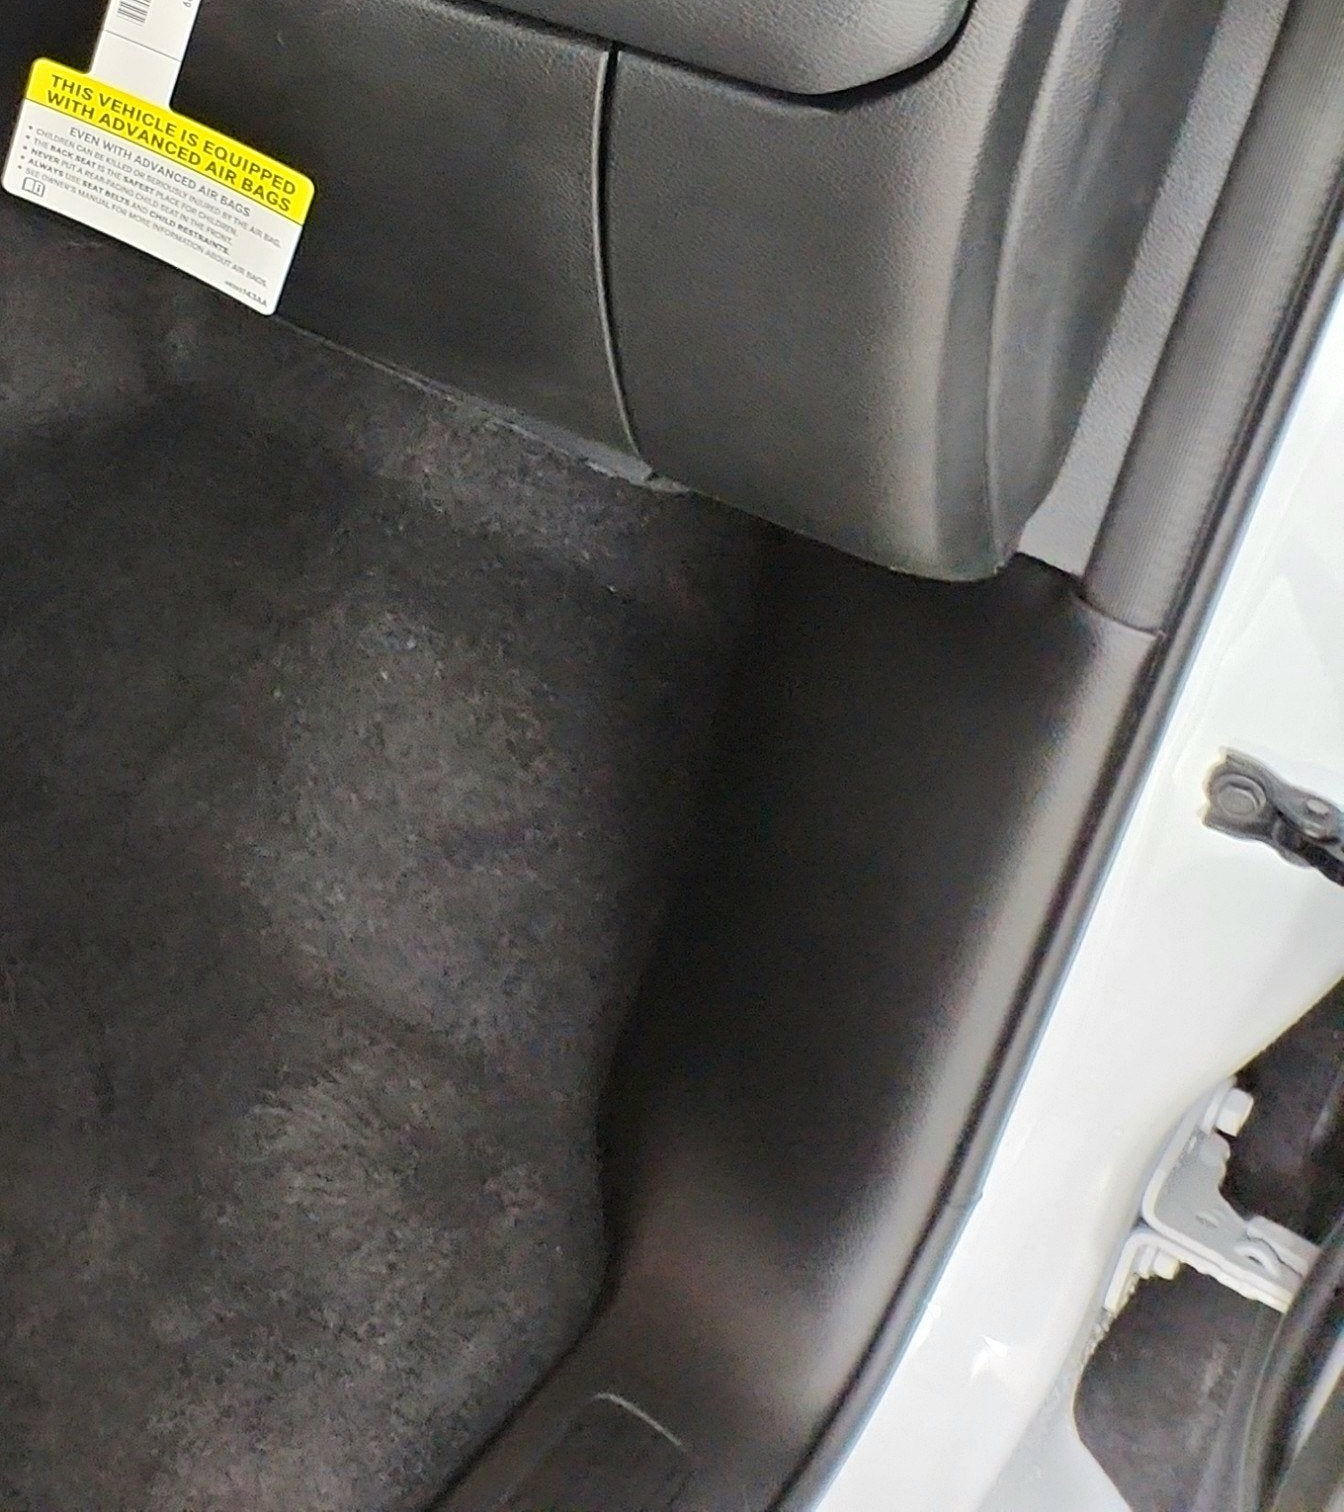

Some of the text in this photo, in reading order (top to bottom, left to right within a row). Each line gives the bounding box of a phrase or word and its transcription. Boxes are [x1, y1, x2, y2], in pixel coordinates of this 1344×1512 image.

[31, 148, 60, 164] NEVER
[61, 160, 76, 171] PUT
[48, 90, 291, 212] WITH ADVANCED AIR BAGS
[50, 145, 74, 159] BACK
[75, 155, 96, 168] SEAT
[123, 176, 155, 194] SAFEST
[52, 74, 296, 195] THIS VEHICLE IS EQUIPPED
[70, 127, 250, 217] EVEN WITH ADVANCED AIR BAGS
[28, 158, 64, 177] ALWAYS
[82, 180, 104, 193] SEAT
[105, 190, 130, 206] BELTS
[149, 210, 176, 227] CHILD
[36, 128, 76, 149] CHILDREN
[76, 144, 93, 157] CAN
[94, 151, 104, 161] BE
[106, 157, 133, 173] KILLED
[234, 217, 249, 230] THE
[250, 226, 263, 238] AIR
